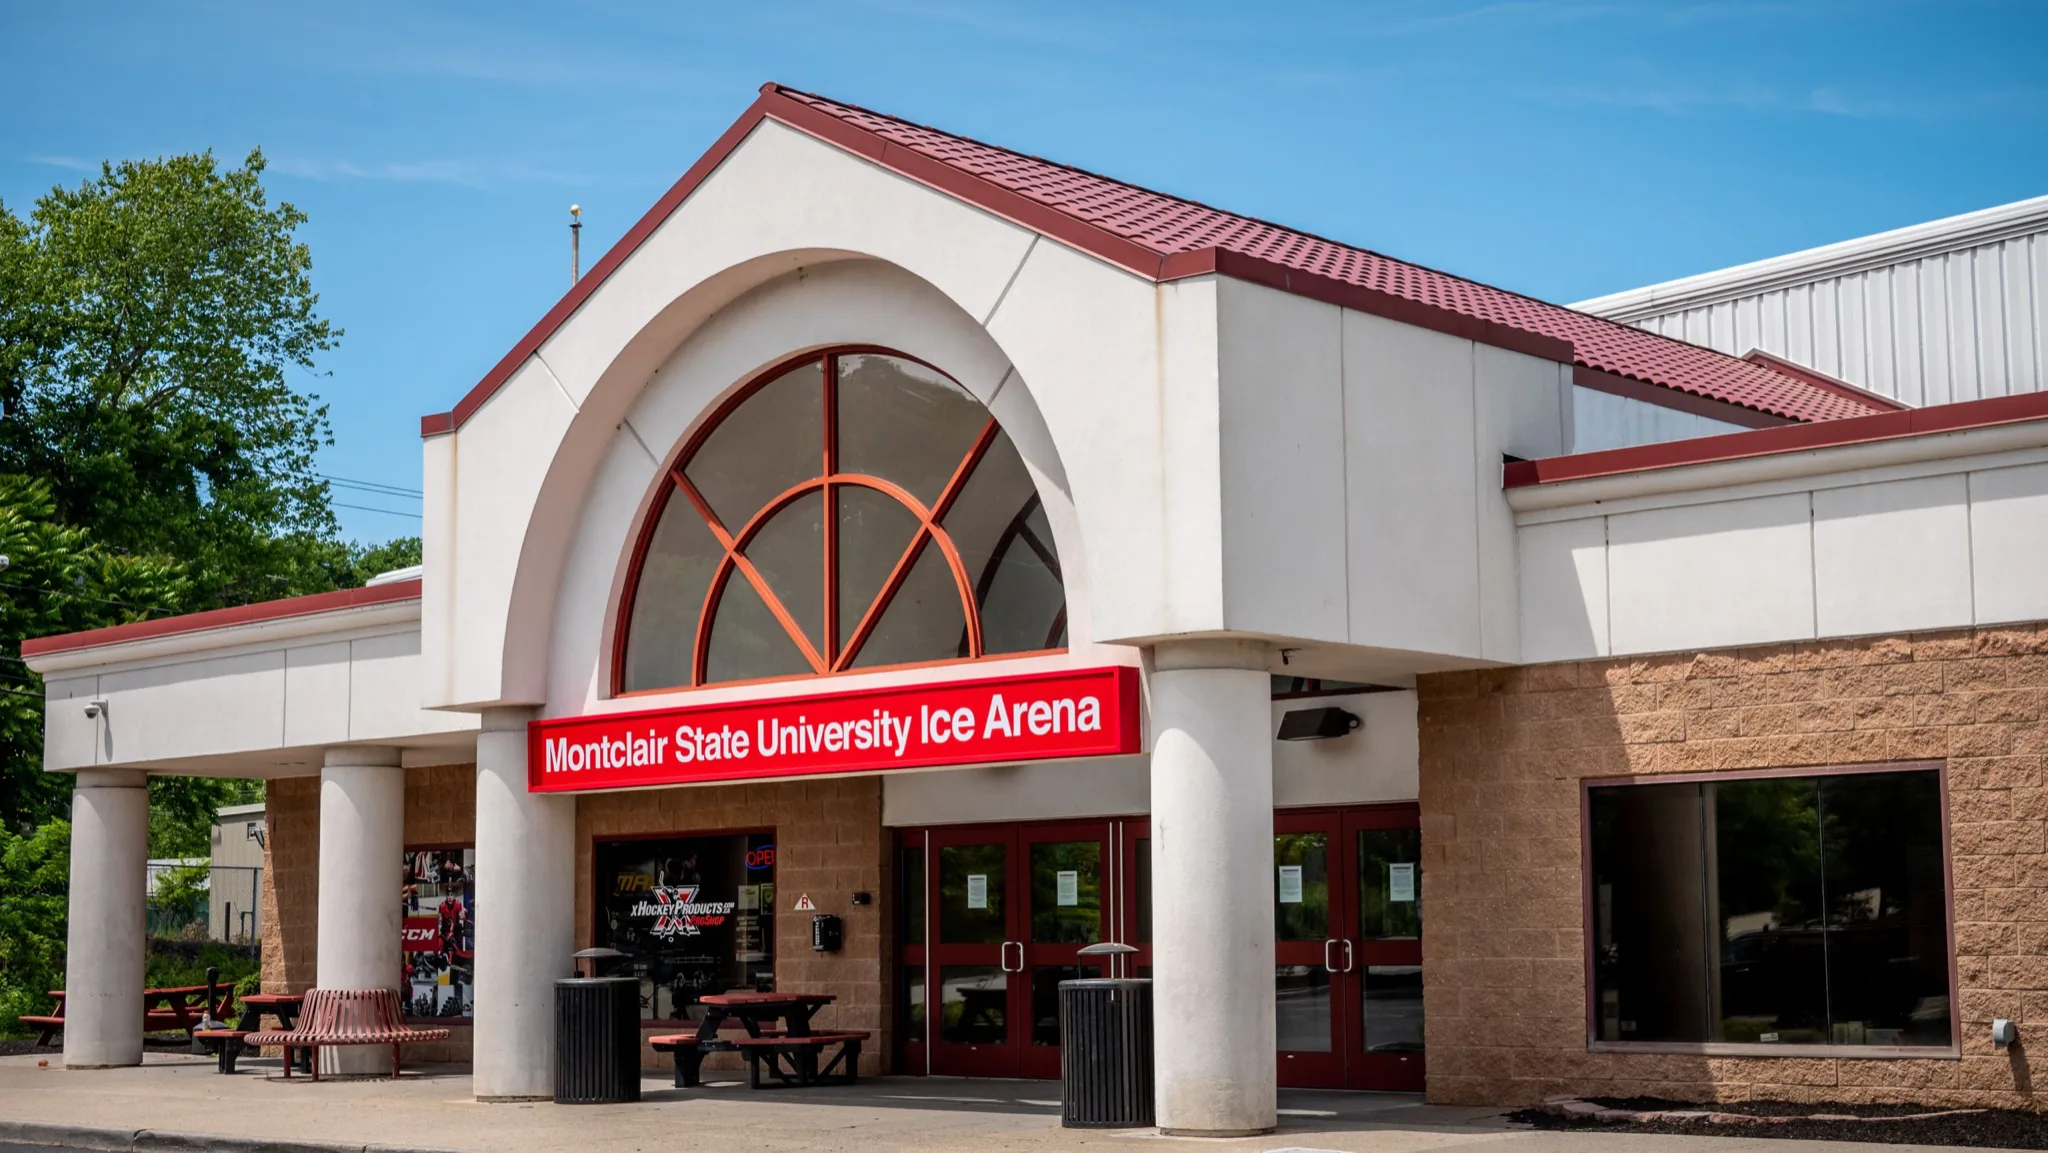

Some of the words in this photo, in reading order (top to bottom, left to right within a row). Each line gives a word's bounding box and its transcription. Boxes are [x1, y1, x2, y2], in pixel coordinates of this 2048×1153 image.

[545, 733, 668, 773] Montclair
[675, 722, 750, 763] State
[757, 709, 911, 758] University
[921, 704, 976, 744] Ice
[982, 694, 1102, 739] Arena
[801, 897, 809, 909] R
